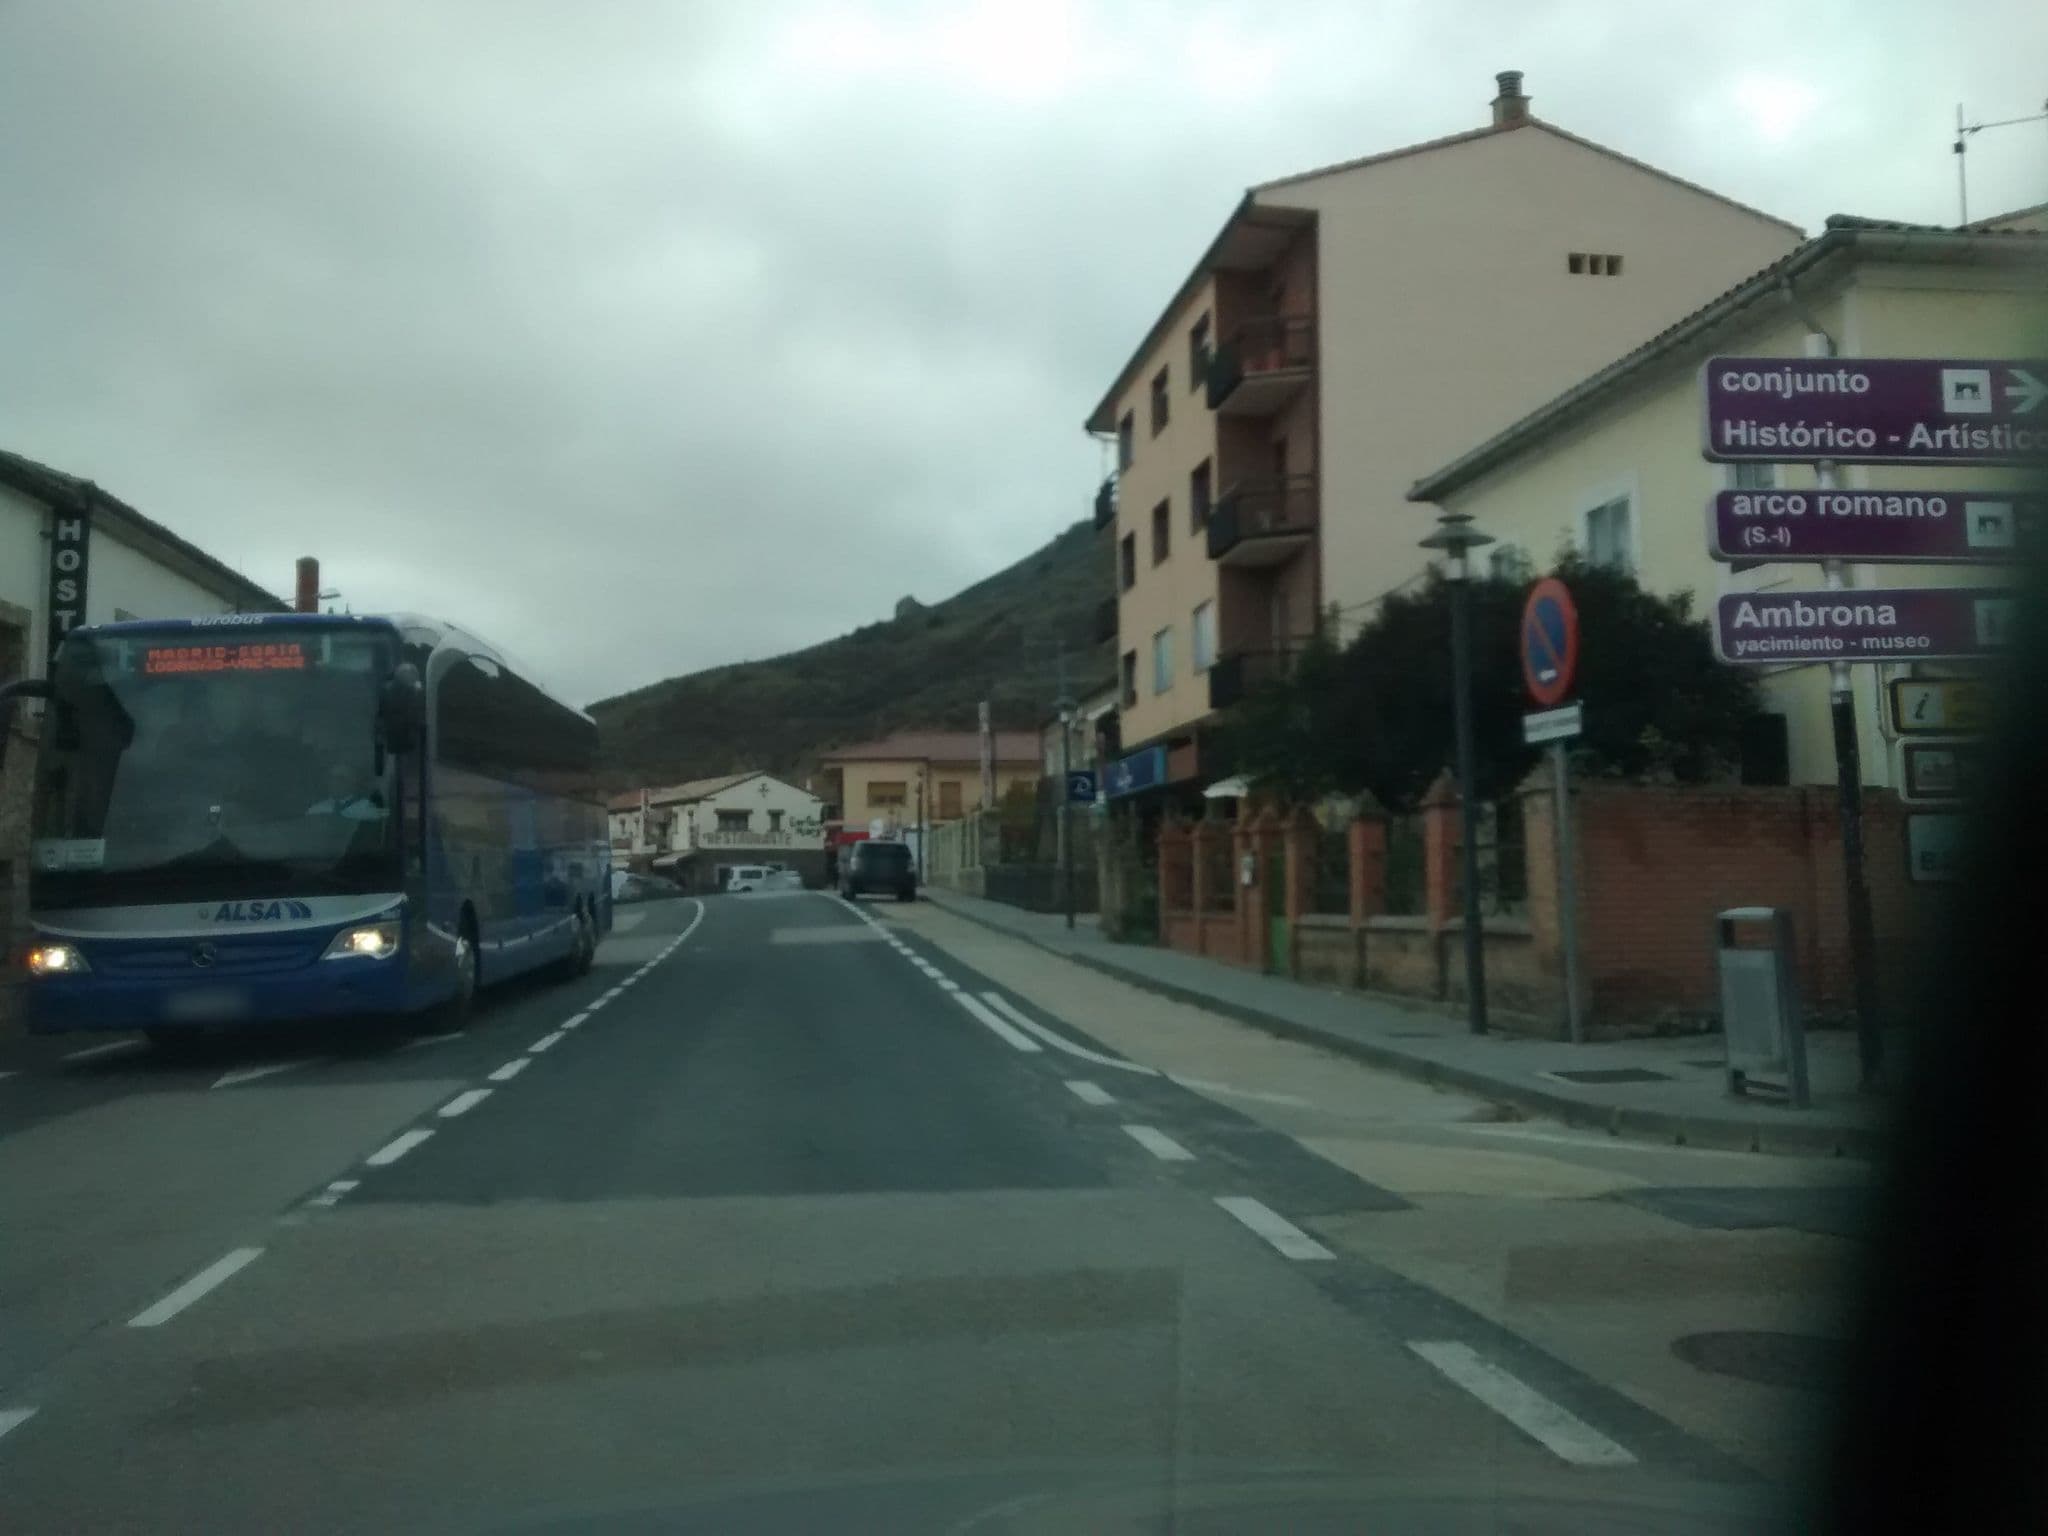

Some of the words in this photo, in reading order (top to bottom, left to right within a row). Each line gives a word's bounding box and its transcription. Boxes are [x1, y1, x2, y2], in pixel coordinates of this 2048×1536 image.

[1721, 367, 1870, 399] conjunto
[1723, 420, 1877, 449] Histórico
[1732, 494, 1807, 516] arco
[1818, 495, 1948, 518] romano
[1734, 600, 1896, 629] Ambrona
[1735, 635, 1844, 656] yacimiento
[1862, 634, 1930, 649] museo
[214, 901, 281, 922] ALSA
